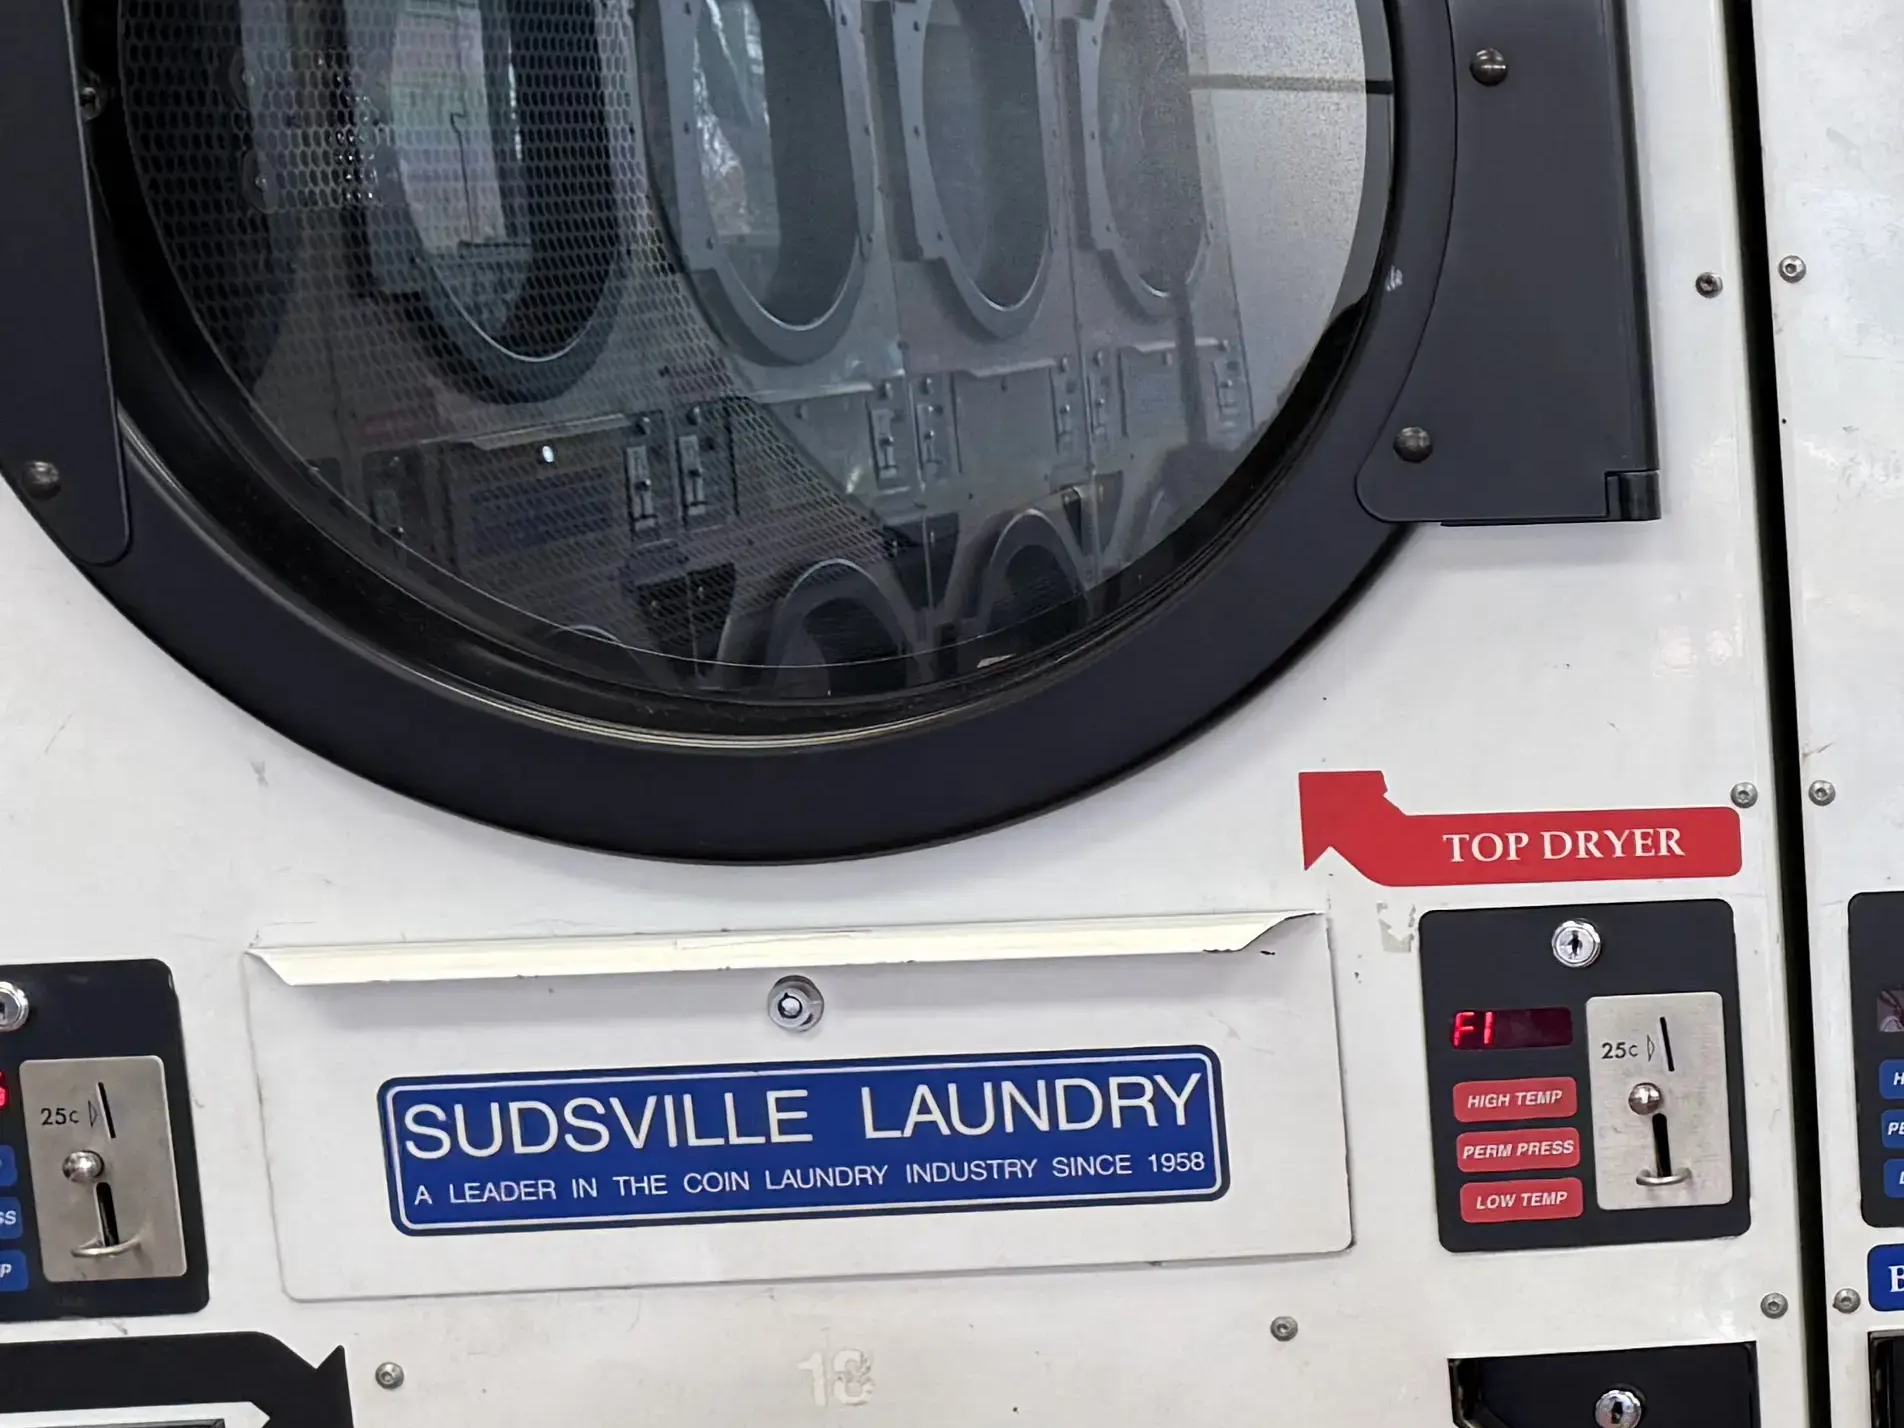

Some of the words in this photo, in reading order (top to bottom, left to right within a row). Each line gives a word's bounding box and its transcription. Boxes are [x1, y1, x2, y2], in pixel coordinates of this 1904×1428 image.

[1442, 832, 1529, 862] TOP
[1540, 827, 1685, 860] DRYER
[1467, 1093, 1511, 1109] HIGH
[1515, 1089, 1563, 1106] TEMP
[404, 1089, 813, 1159] SUDSVILLE
[861, 1072, 1202, 1139] LAUNDRY
[1462, 1143, 1513, 1160] PERM
[1516, 1139, 1575, 1157] PRESS
[414, 1184, 433, 1206] A
[449, 1179, 557, 1204] LEADER
[571, 1177, 598, 1199] IN
[612, 1174, 669, 1197] THE
[683, 1170, 750, 1194] COIN
[765, 1164, 889, 1190] LAUNDRY
[905, 1158, 1038, 1184] INDUSTRY
[1052, 1154, 1133, 1178] SINCE
[1147, 1151, 1205, 1173] 1958
[1476, 1193, 1517, 1210] LOW
[1520, 1191, 1568, 1207] TEMP
